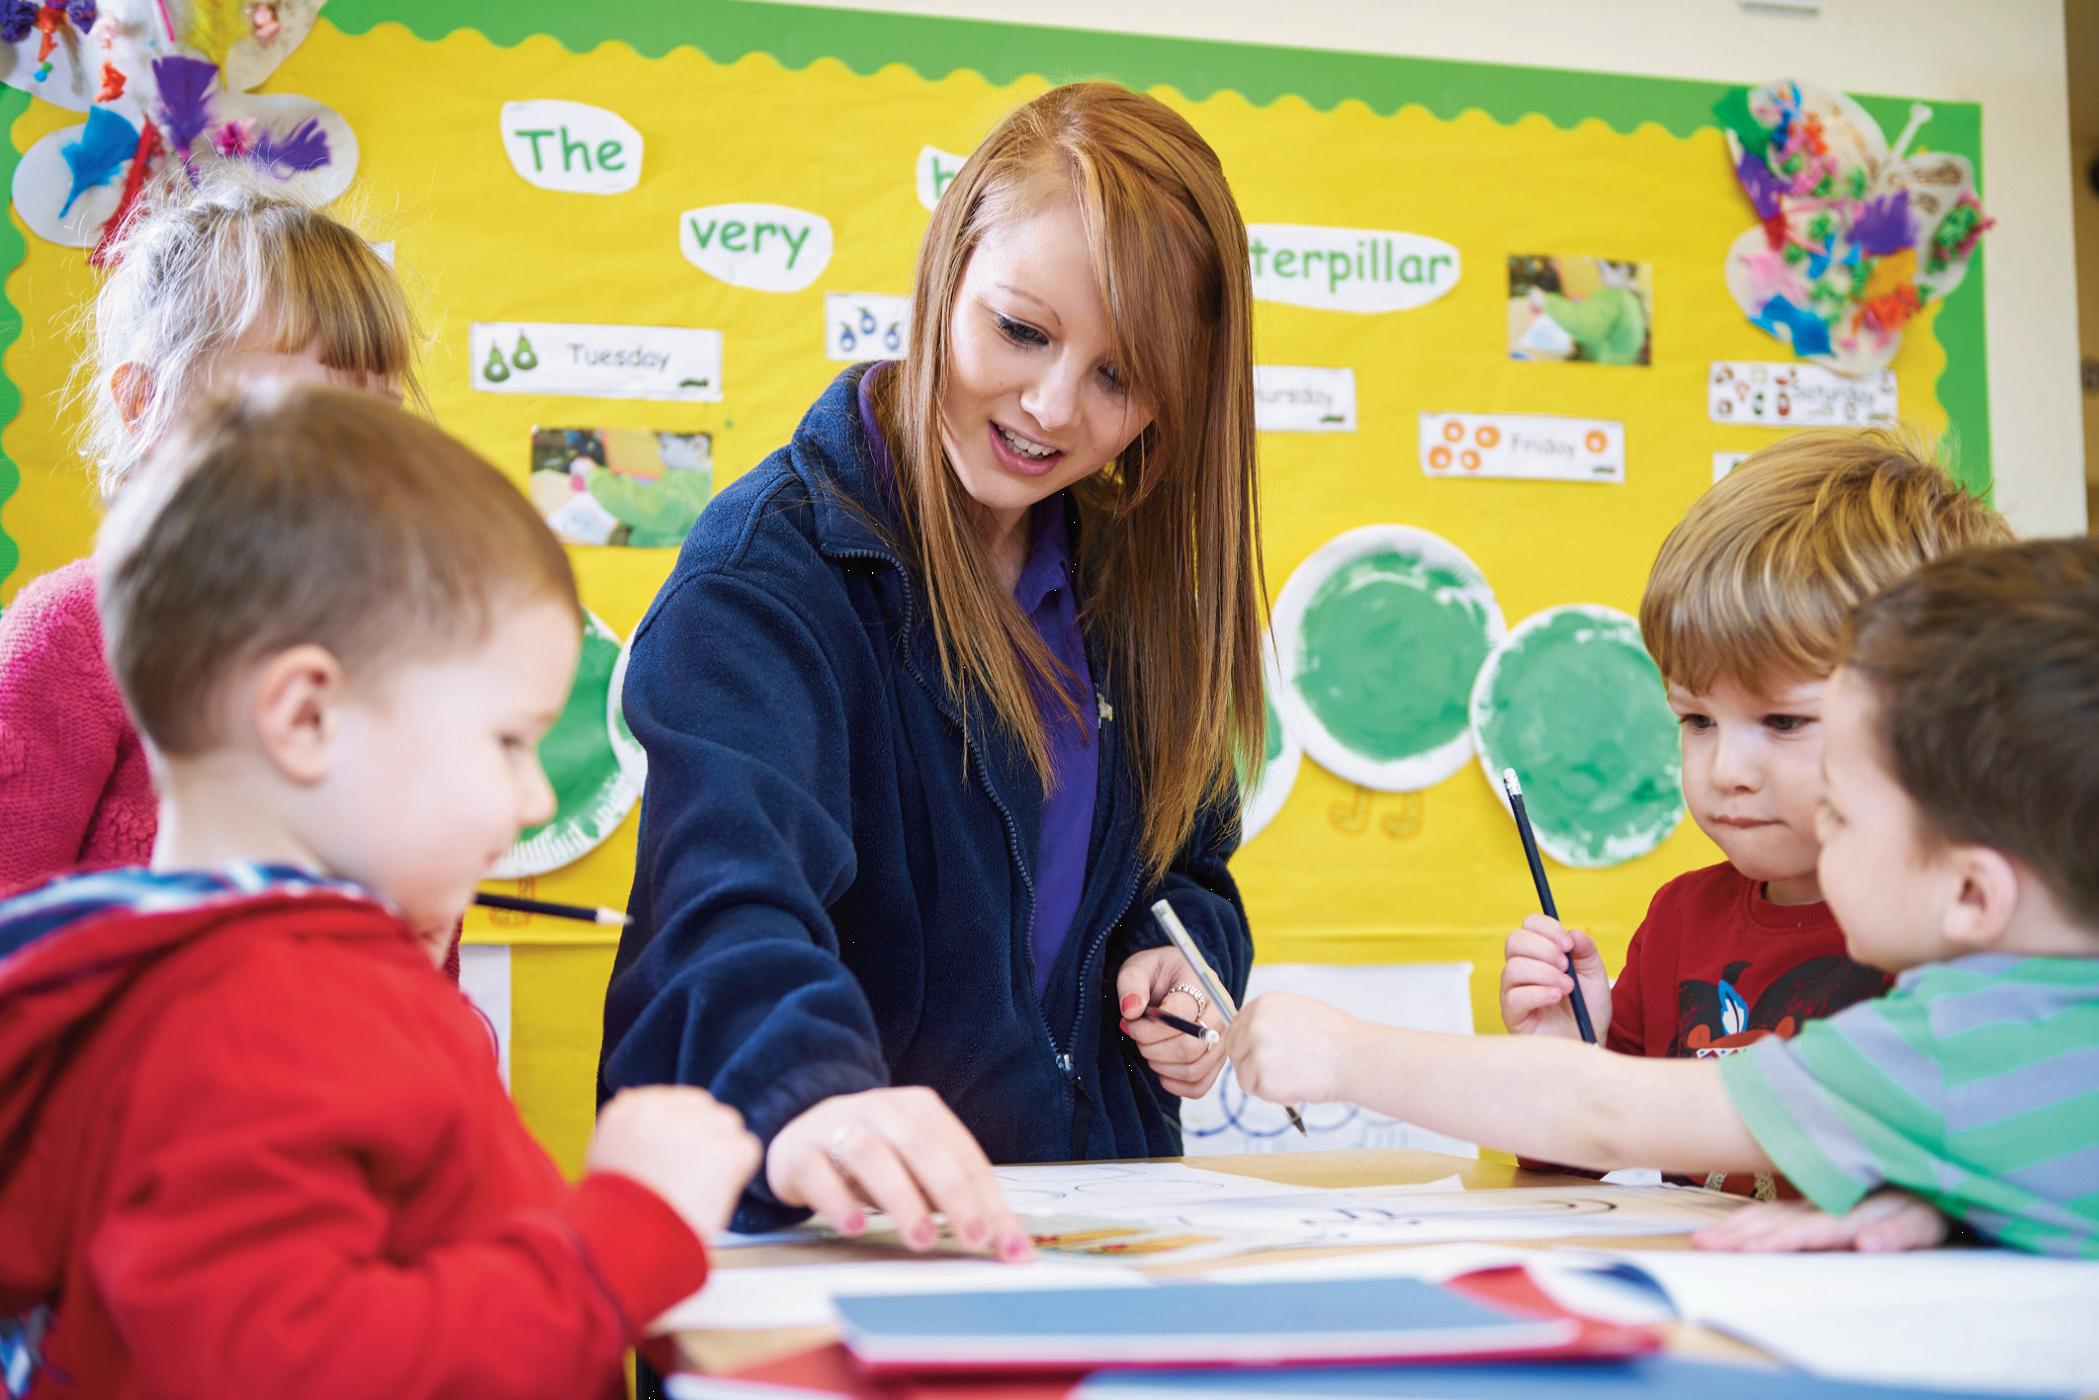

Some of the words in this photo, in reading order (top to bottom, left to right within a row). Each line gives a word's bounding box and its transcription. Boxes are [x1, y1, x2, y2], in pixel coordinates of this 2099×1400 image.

[514, 125, 626, 173] The
[689, 217, 811, 270] very
[567, 342, 671, 374] Tuesday
[1509, 430, 1576, 461] Friday
